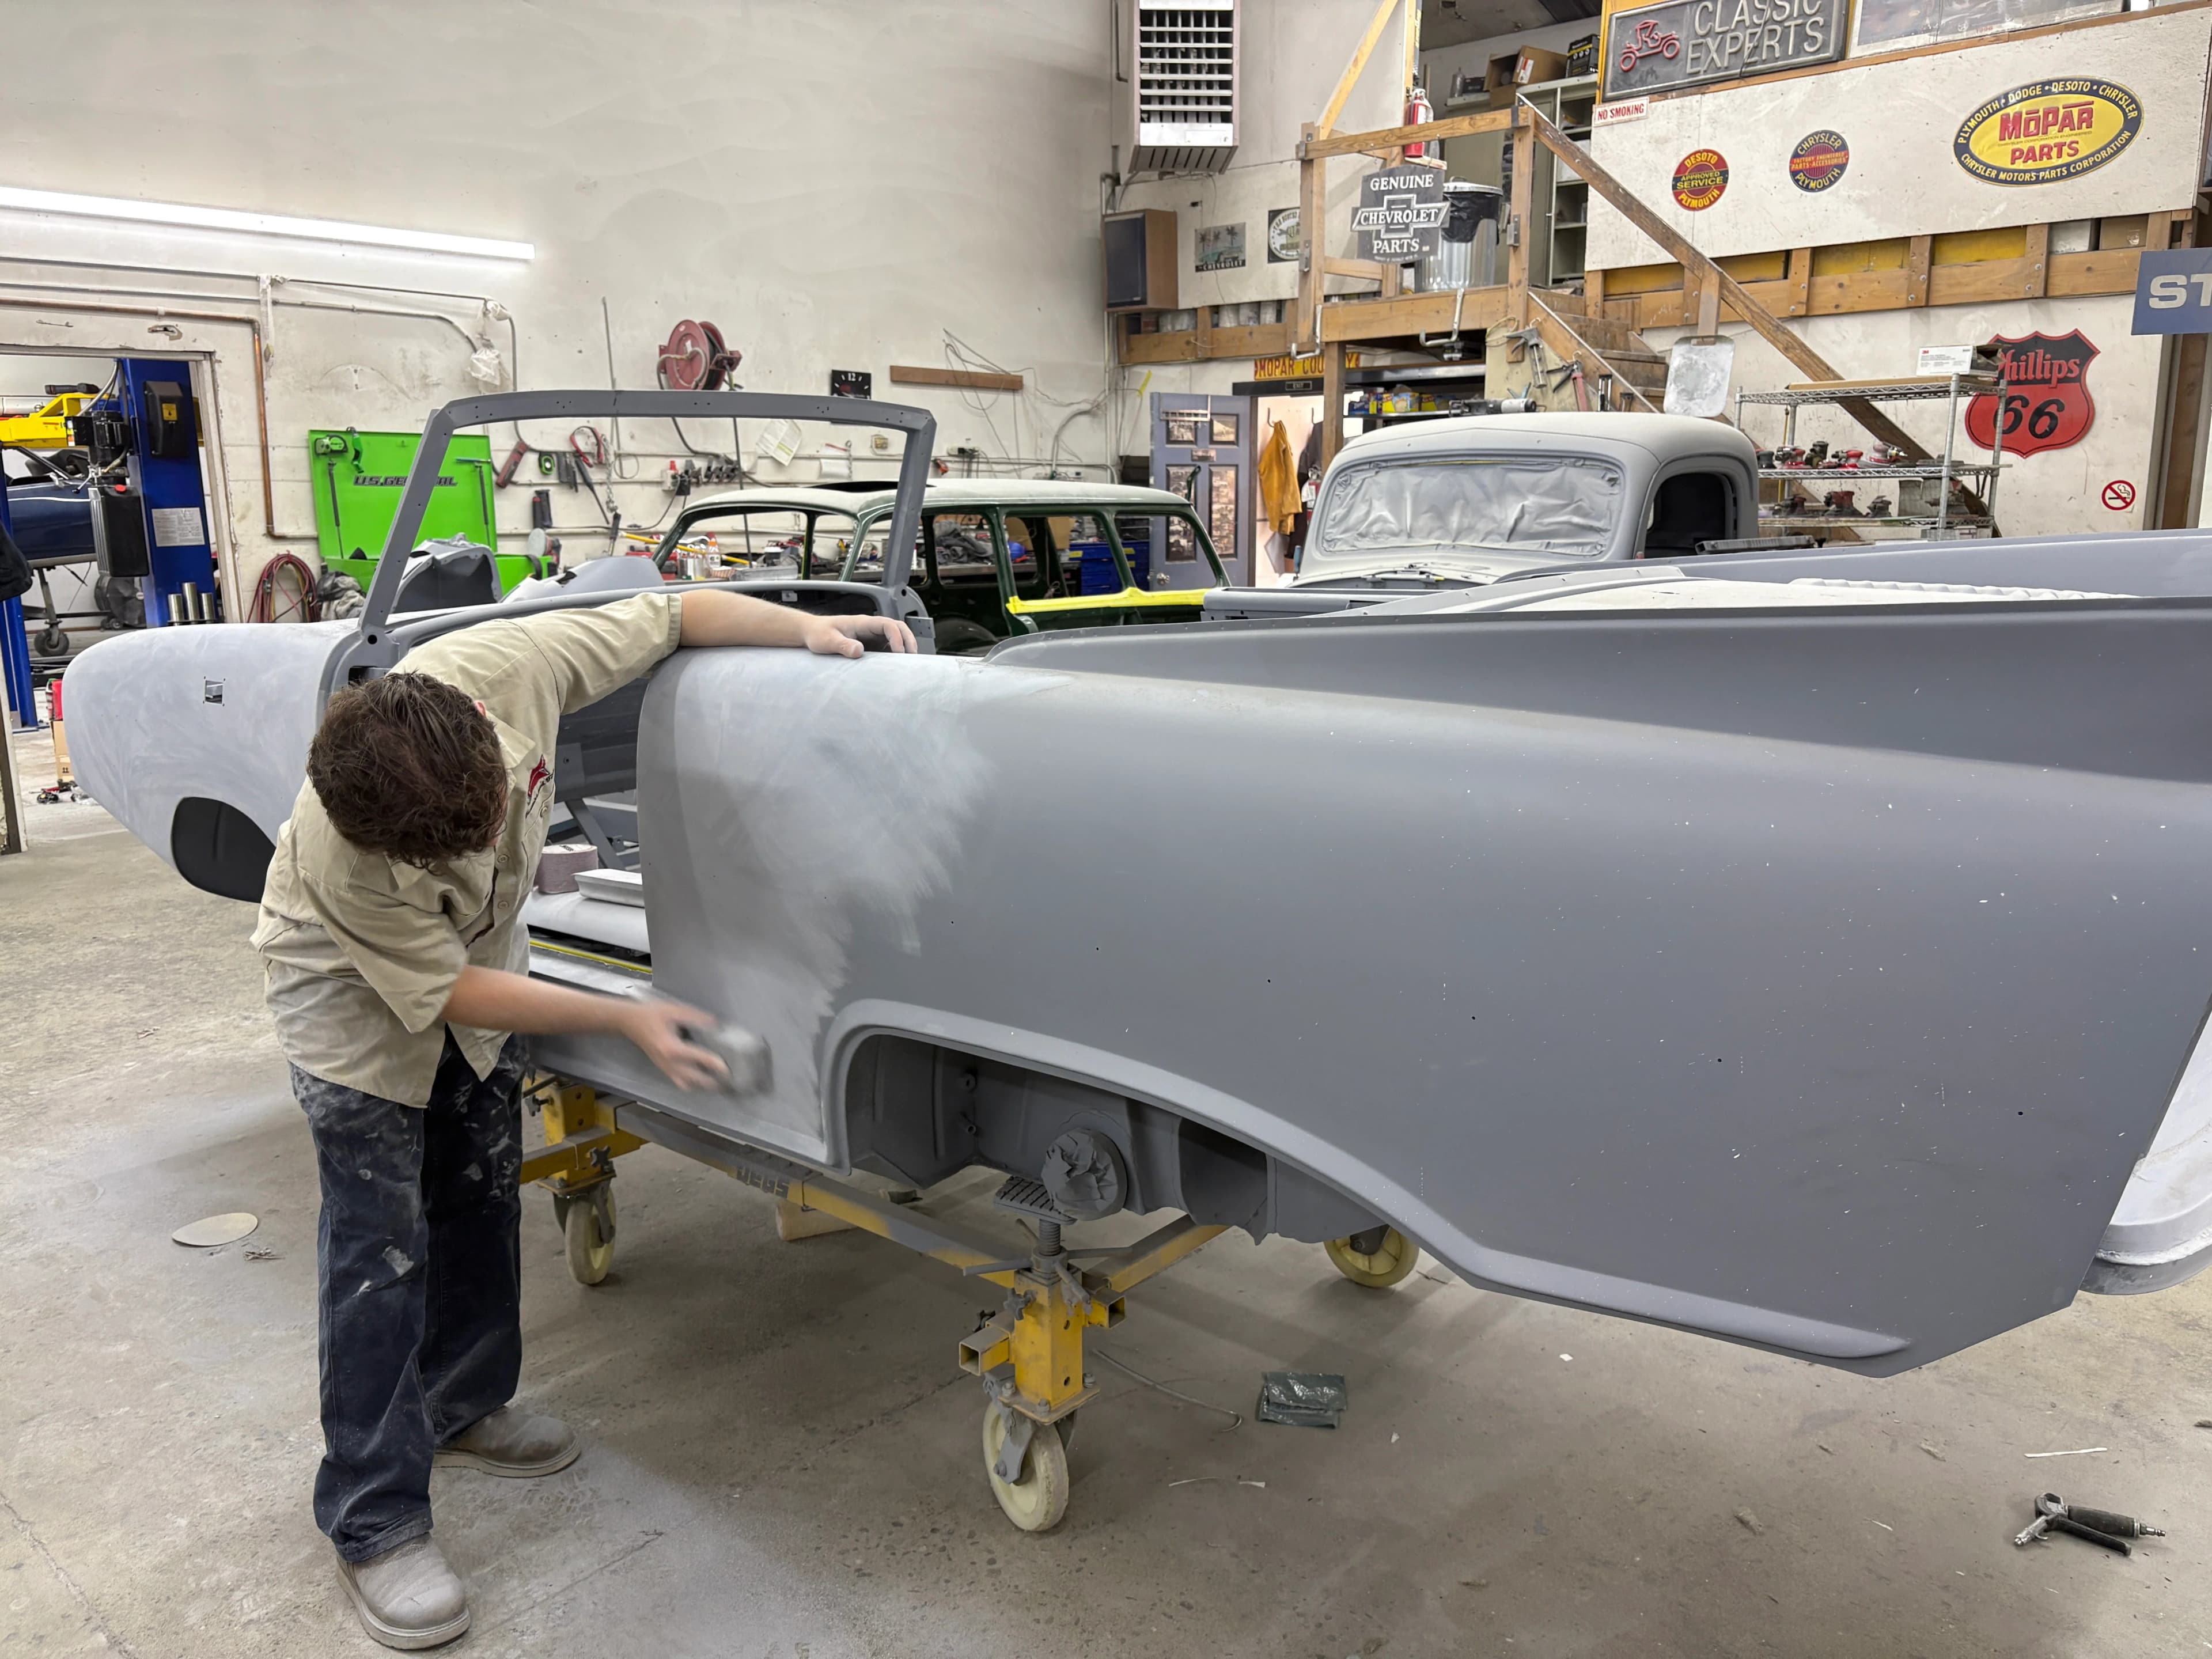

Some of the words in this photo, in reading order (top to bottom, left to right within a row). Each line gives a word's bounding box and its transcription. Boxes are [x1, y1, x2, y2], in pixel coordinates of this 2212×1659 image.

[1686, 17, 1824, 74] EXPERTS
[1597, 109, 1608, 121] NO
[1610, 103, 1645, 119] SMOKING
[1958, 100, 1999, 143] PLYMOUTH
[2008, 84, 2042, 103] DODGE
[2051, 81, 2091, 92] DESOTO
[2099, 85, 2138, 119] CHRYSLER
[1999, 101, 2094, 142] MOPAR
[1797, 133, 1843, 155] CHRYSLER
[2024, 135, 2059, 143] CORPORATION
[2059, 131, 2093, 139] ENGINEERED
[1684, 152, 1718, 168] DESOTO
[1961, 153, 1997, 179] CHRYSLER
[1998, 171, 2036, 181] MOTORS
[2039, 169, 2067, 180] PARTS
[2070, 130, 2132, 173] CORPORATION
[2010, 140, 2080, 165] PARTS
[1370, 175, 1434, 191] GENUINE
[1676, 177, 1724, 190] SERVICE
[1681, 171, 1720, 181] APPROVED
[1794, 168, 1841, 189] PLYMOUTH
[1678, 188, 1721, 208] PLYMOUTH
[1361, 209, 1438, 225] CHEVROLET
[1373, 238, 1419, 253] PARTS
[1203, 260, 1243, 271] CHEVROLET
[2149, 273, 2212, 309] ST
[848, 373, 856, 381] 12
[1259, 358, 1294, 377] MOPAR
[1993, 395, 2065, 439] 66
